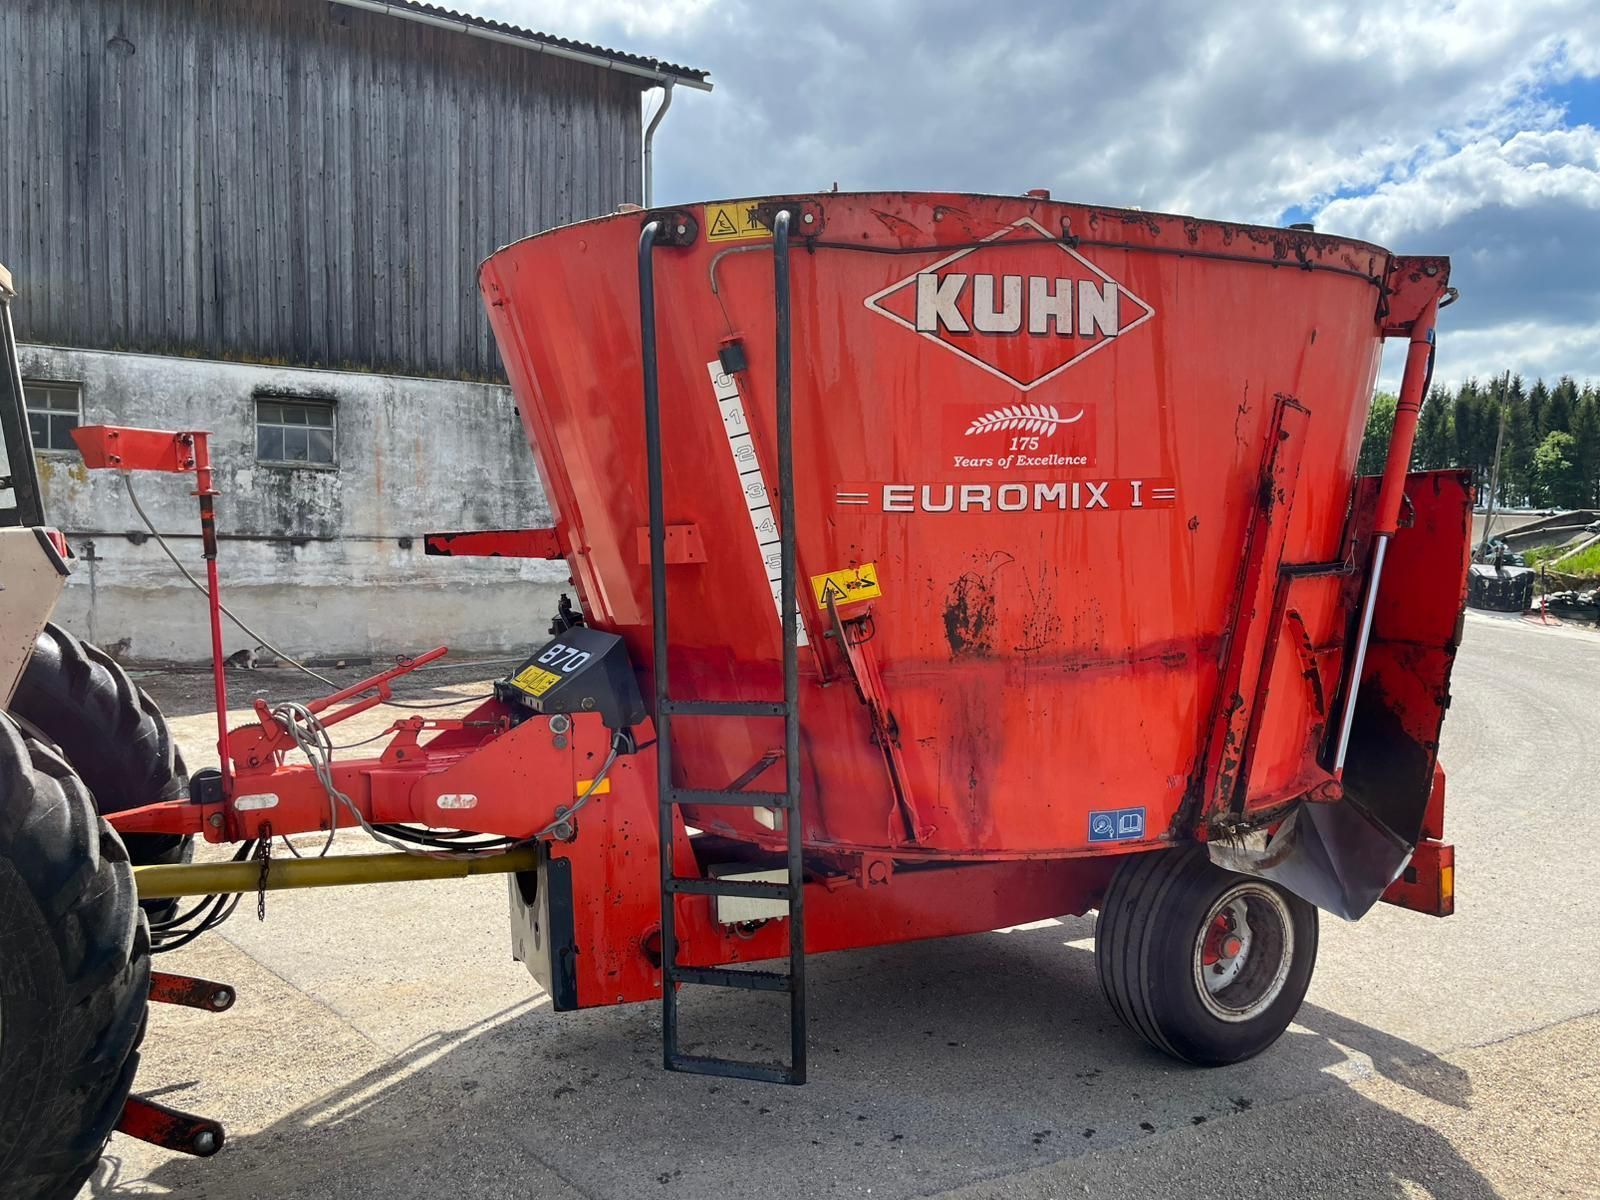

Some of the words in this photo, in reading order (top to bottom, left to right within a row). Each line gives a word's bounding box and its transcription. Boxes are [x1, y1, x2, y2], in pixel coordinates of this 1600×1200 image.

[916, 273, 1119, 338] KUHN
[729, 408, 741, 425] 1
[1009, 436, 1040, 451] 175
[736, 444, 755, 463] 2
[953, 455, 993, 468] Years
[997, 454, 1014, 469] of
[1016, 454, 1087, 467] Excellence
[746, 482, 765, 499] 3
[882, 481, 1109, 512] EUROMIX
[1130, 480, 1143, 506] I
[758, 517, 775, 534] 4
[537, 643, 592, 673] 870
